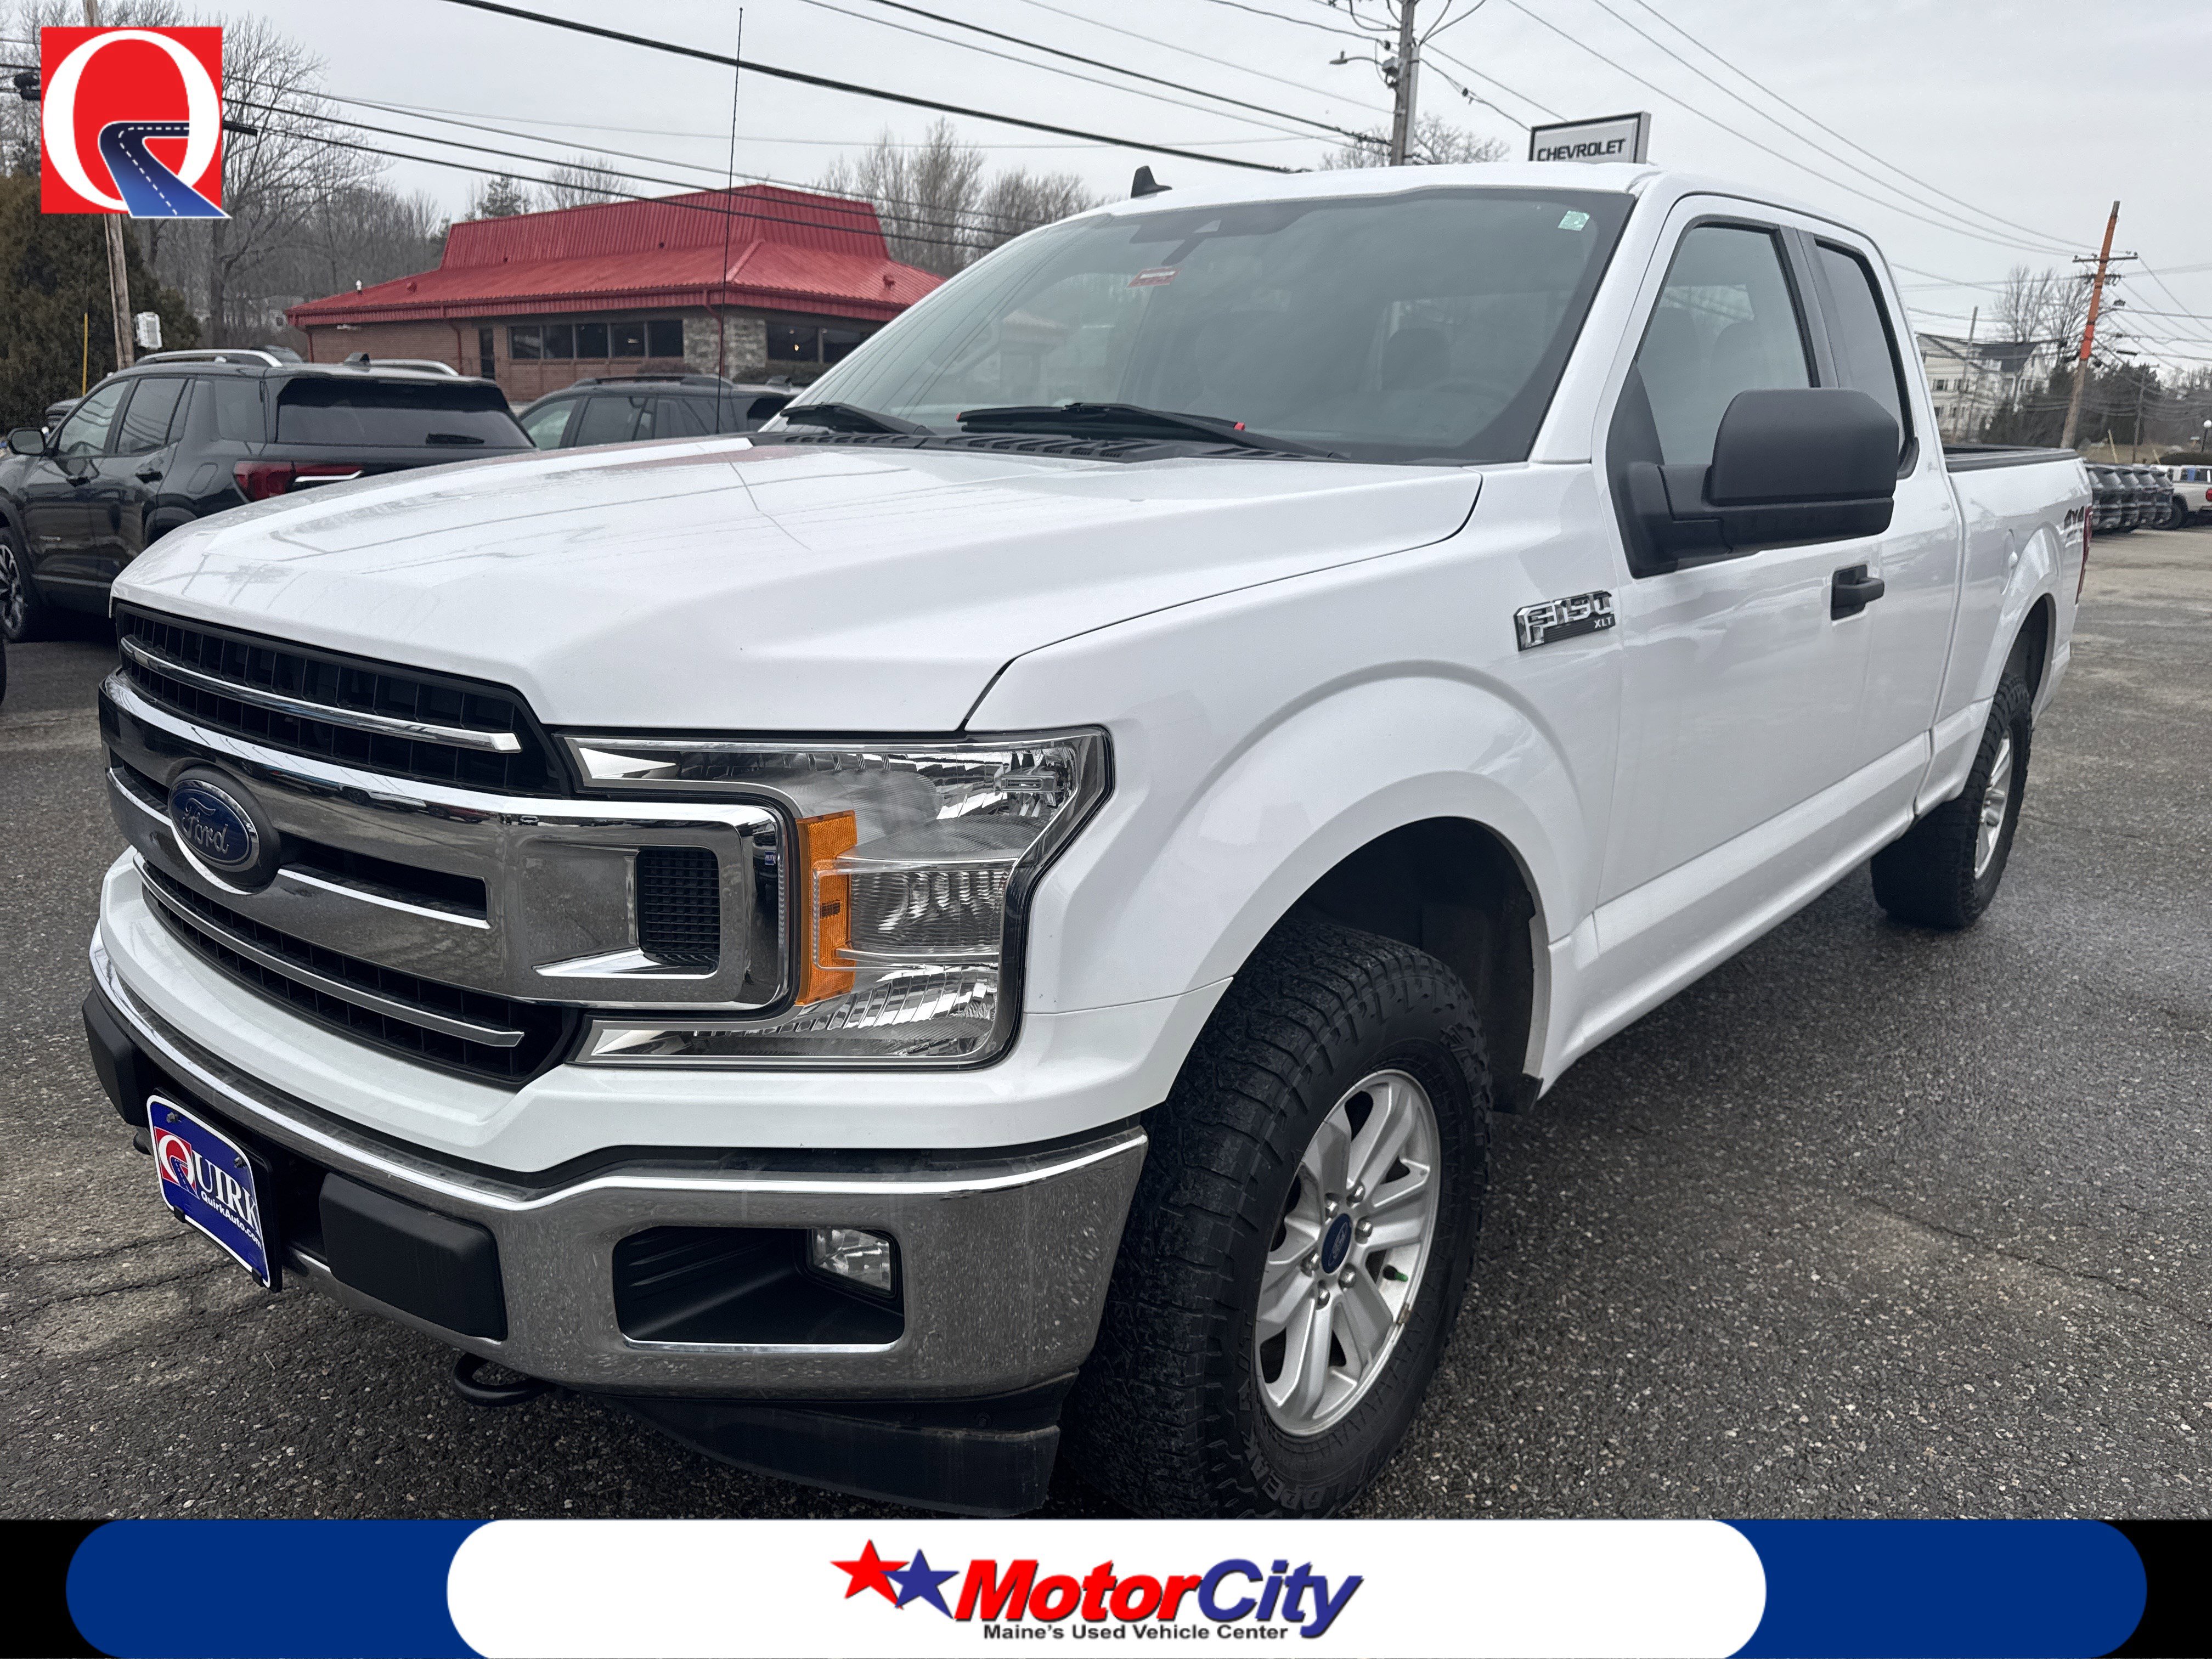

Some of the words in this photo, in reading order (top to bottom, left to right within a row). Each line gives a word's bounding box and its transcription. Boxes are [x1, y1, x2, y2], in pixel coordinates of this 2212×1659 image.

[1537, 138, 1626, 161] CHEVROLET
[1594, 616, 1612, 629] XLT
[182, 797, 229, 854] Ford
[158, 1134, 262, 1240] QUIRK
[201, 1190, 262, 1250] QuirkAuto.com
